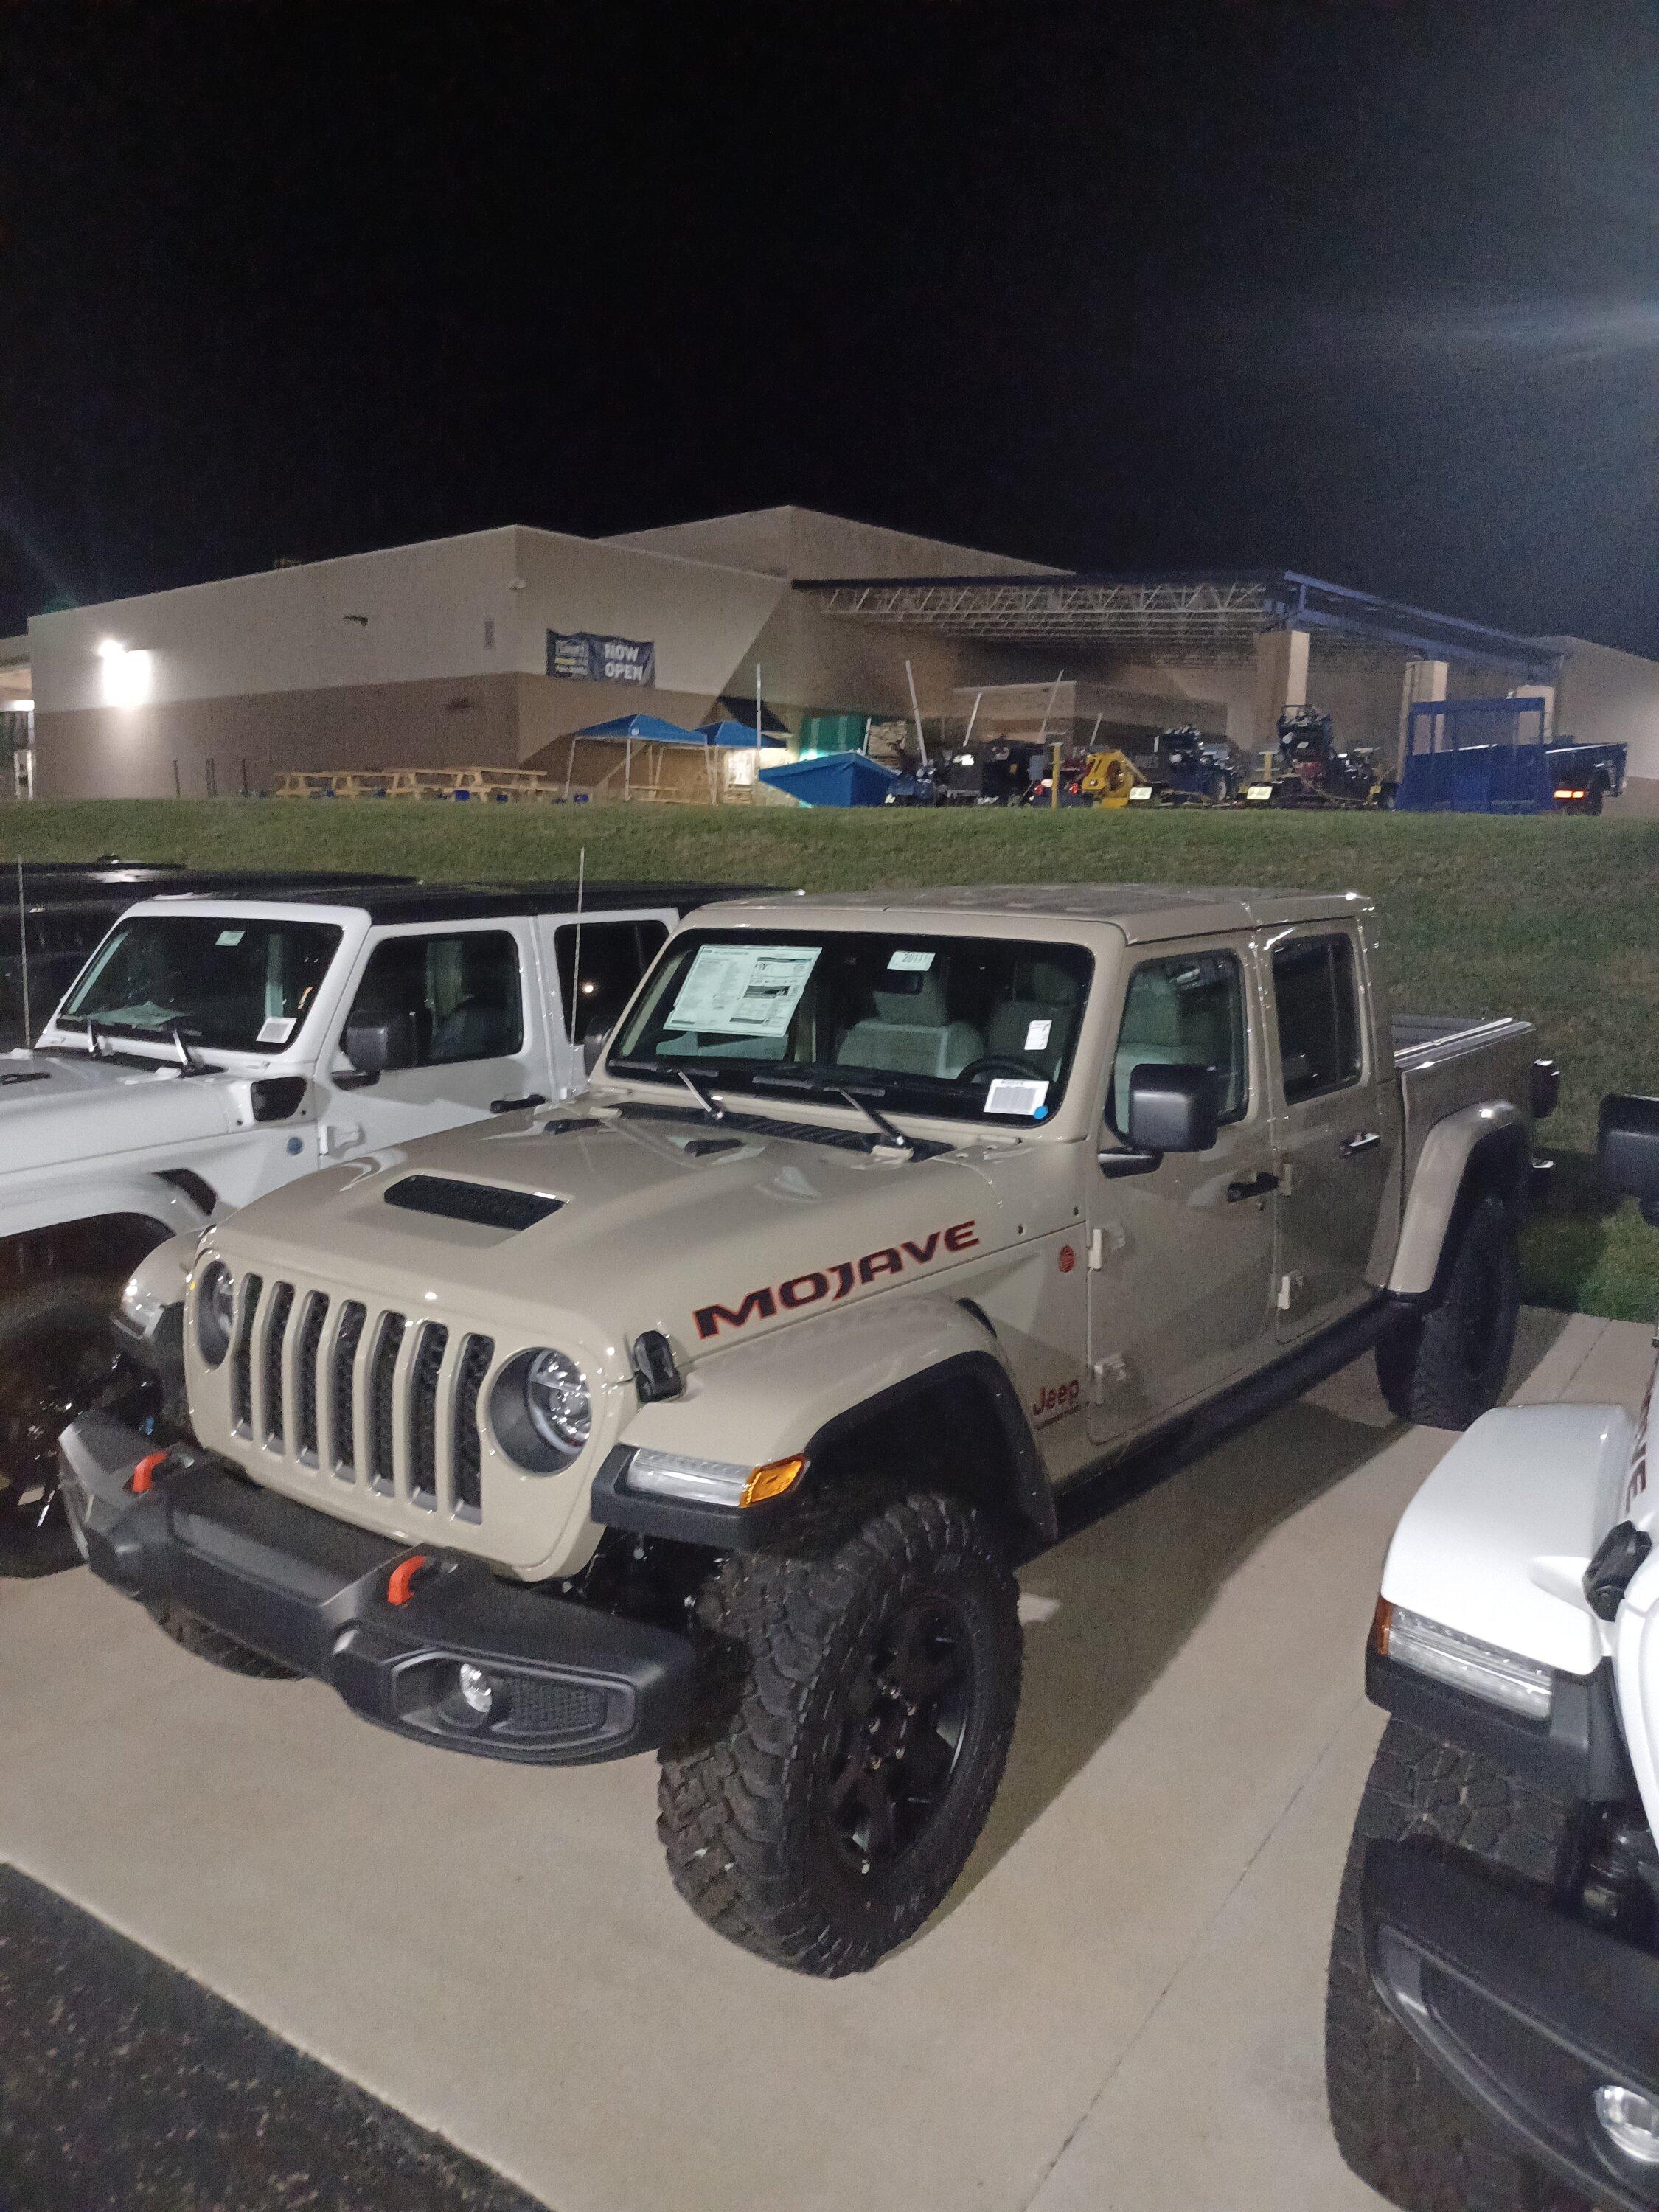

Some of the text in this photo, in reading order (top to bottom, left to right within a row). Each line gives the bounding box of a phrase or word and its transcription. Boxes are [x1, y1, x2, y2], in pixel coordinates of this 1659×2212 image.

[604, 643, 639, 661] NOW
[605, 662, 643, 681] OPEN
[692, 1220, 980, 1339] MOJAVE
[1034, 1379, 1079, 1415] Jeep
